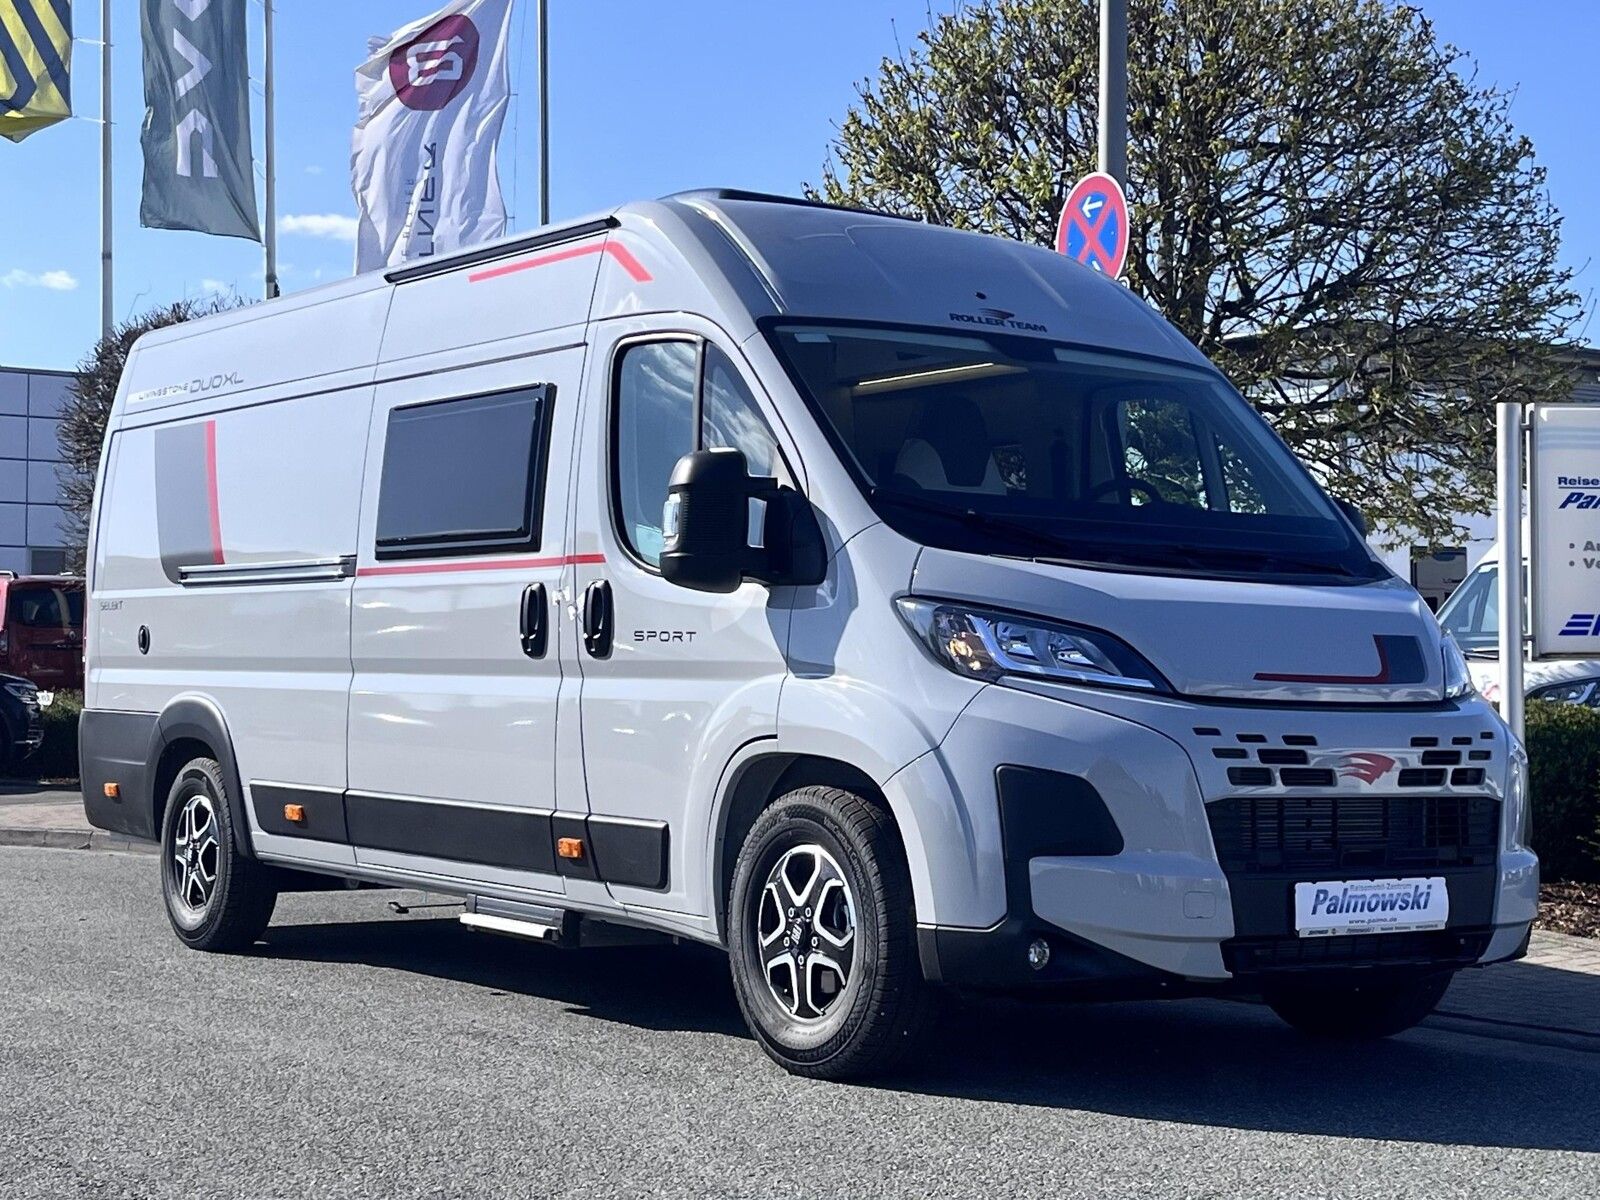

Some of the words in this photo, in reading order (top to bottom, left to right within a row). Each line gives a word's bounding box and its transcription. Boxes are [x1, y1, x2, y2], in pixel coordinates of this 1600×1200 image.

[949, 313, 1006, 327] ROLLER
[1008, 320, 1047, 333] TEAM
[633, 630, 697, 642] SPORT
[1311, 884, 1432, 916] Palmowski
